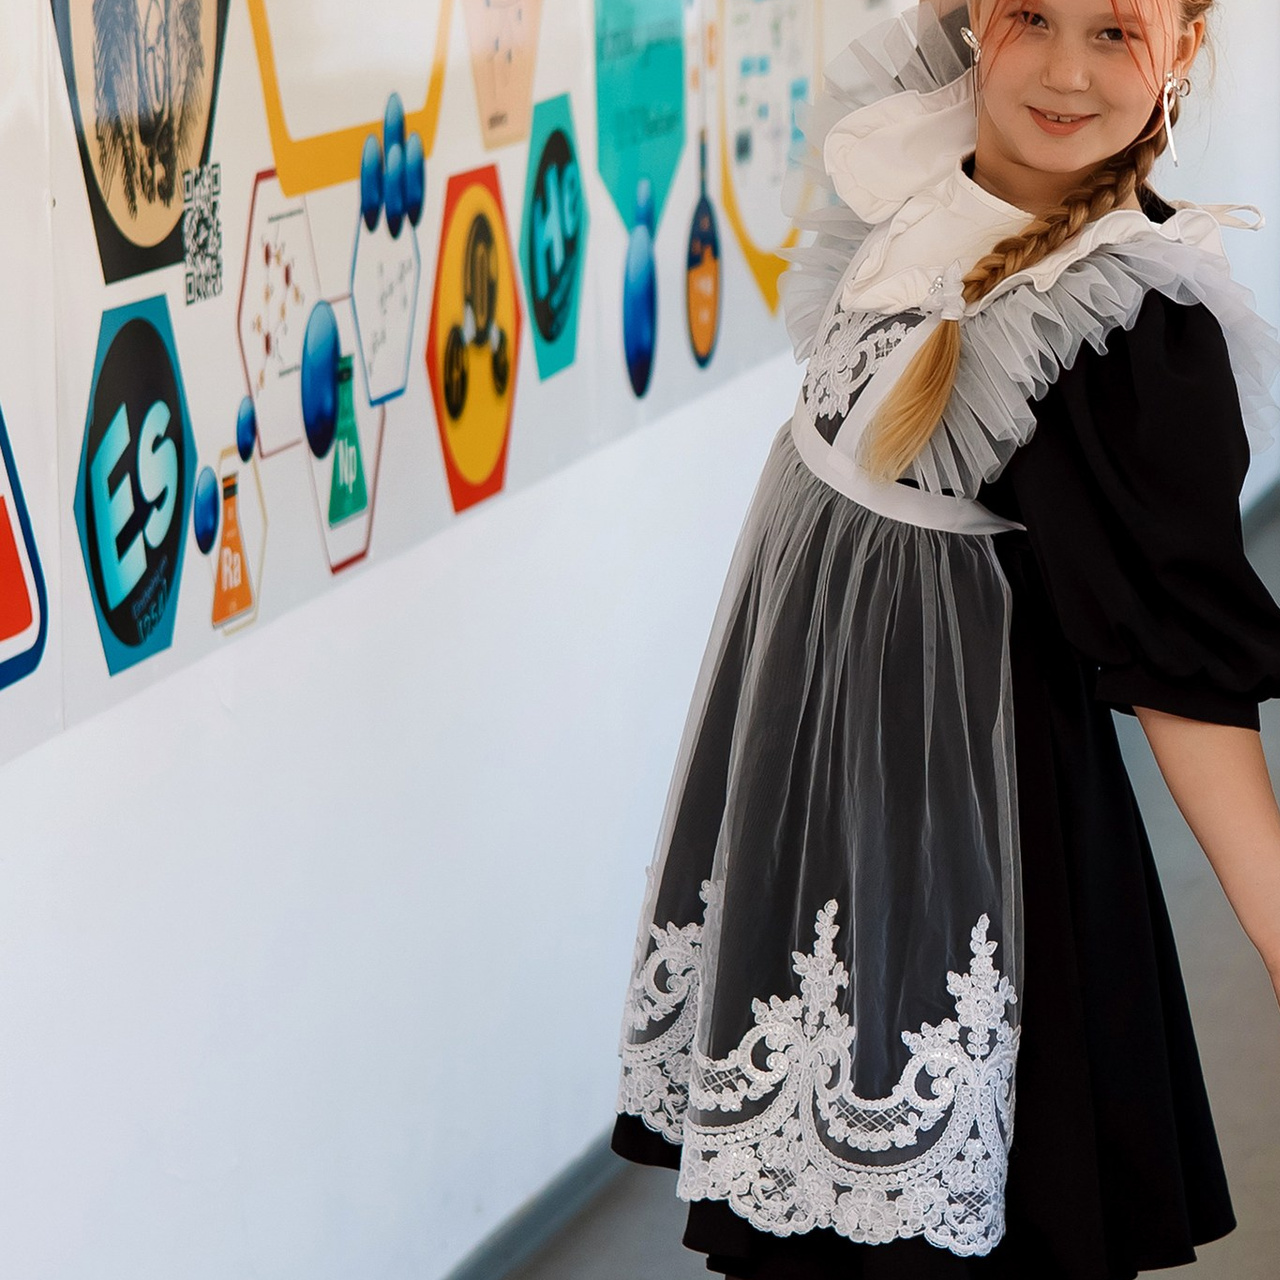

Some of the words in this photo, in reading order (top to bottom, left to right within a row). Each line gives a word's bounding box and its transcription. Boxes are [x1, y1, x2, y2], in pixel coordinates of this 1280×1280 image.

[534, 161, 580, 301] He
[338, 437, 358, 494] Np
[221, 546, 242, 592] Ra
